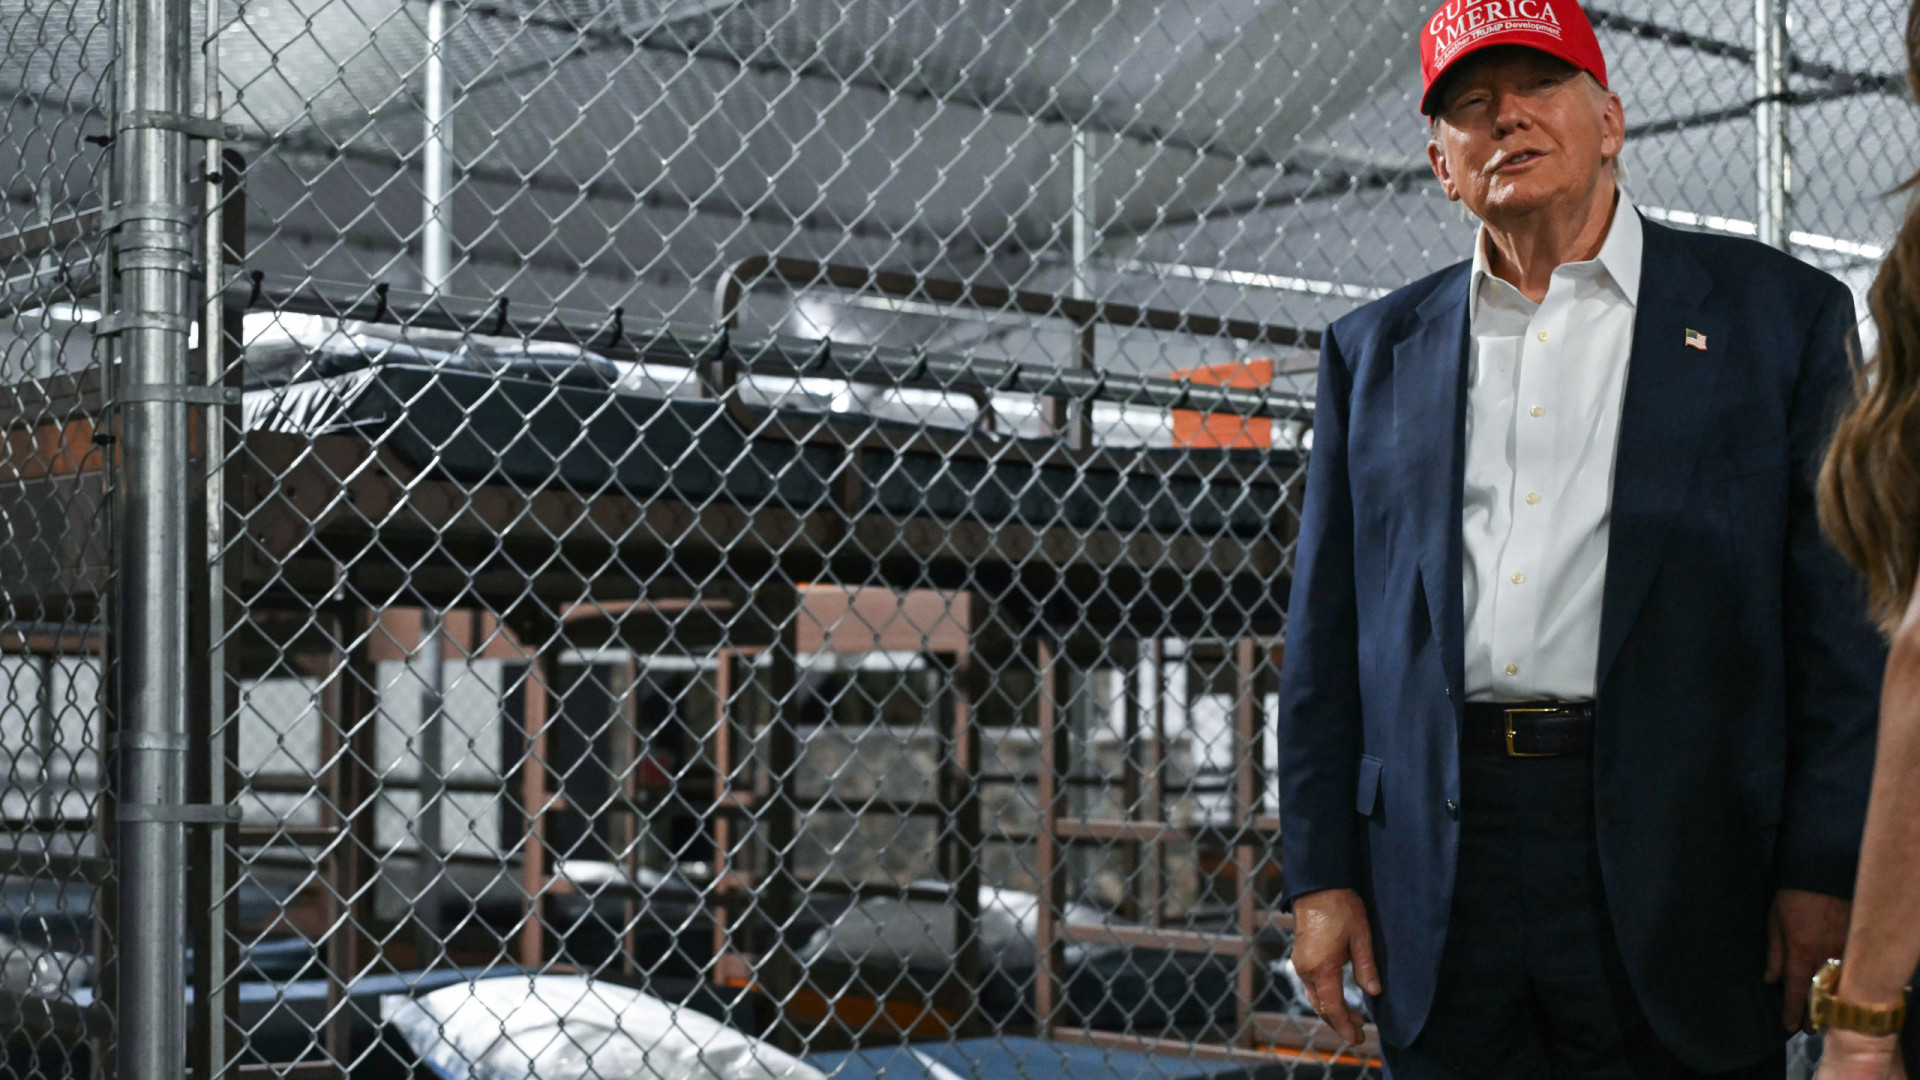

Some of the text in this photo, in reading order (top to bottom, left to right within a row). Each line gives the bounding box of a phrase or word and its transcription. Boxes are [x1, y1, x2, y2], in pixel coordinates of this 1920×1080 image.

[1434, 0, 1560, 61] AMERICA
[1444, 36, 1470, 60] Another
[1470, 23, 1503, 40] TRUMP
